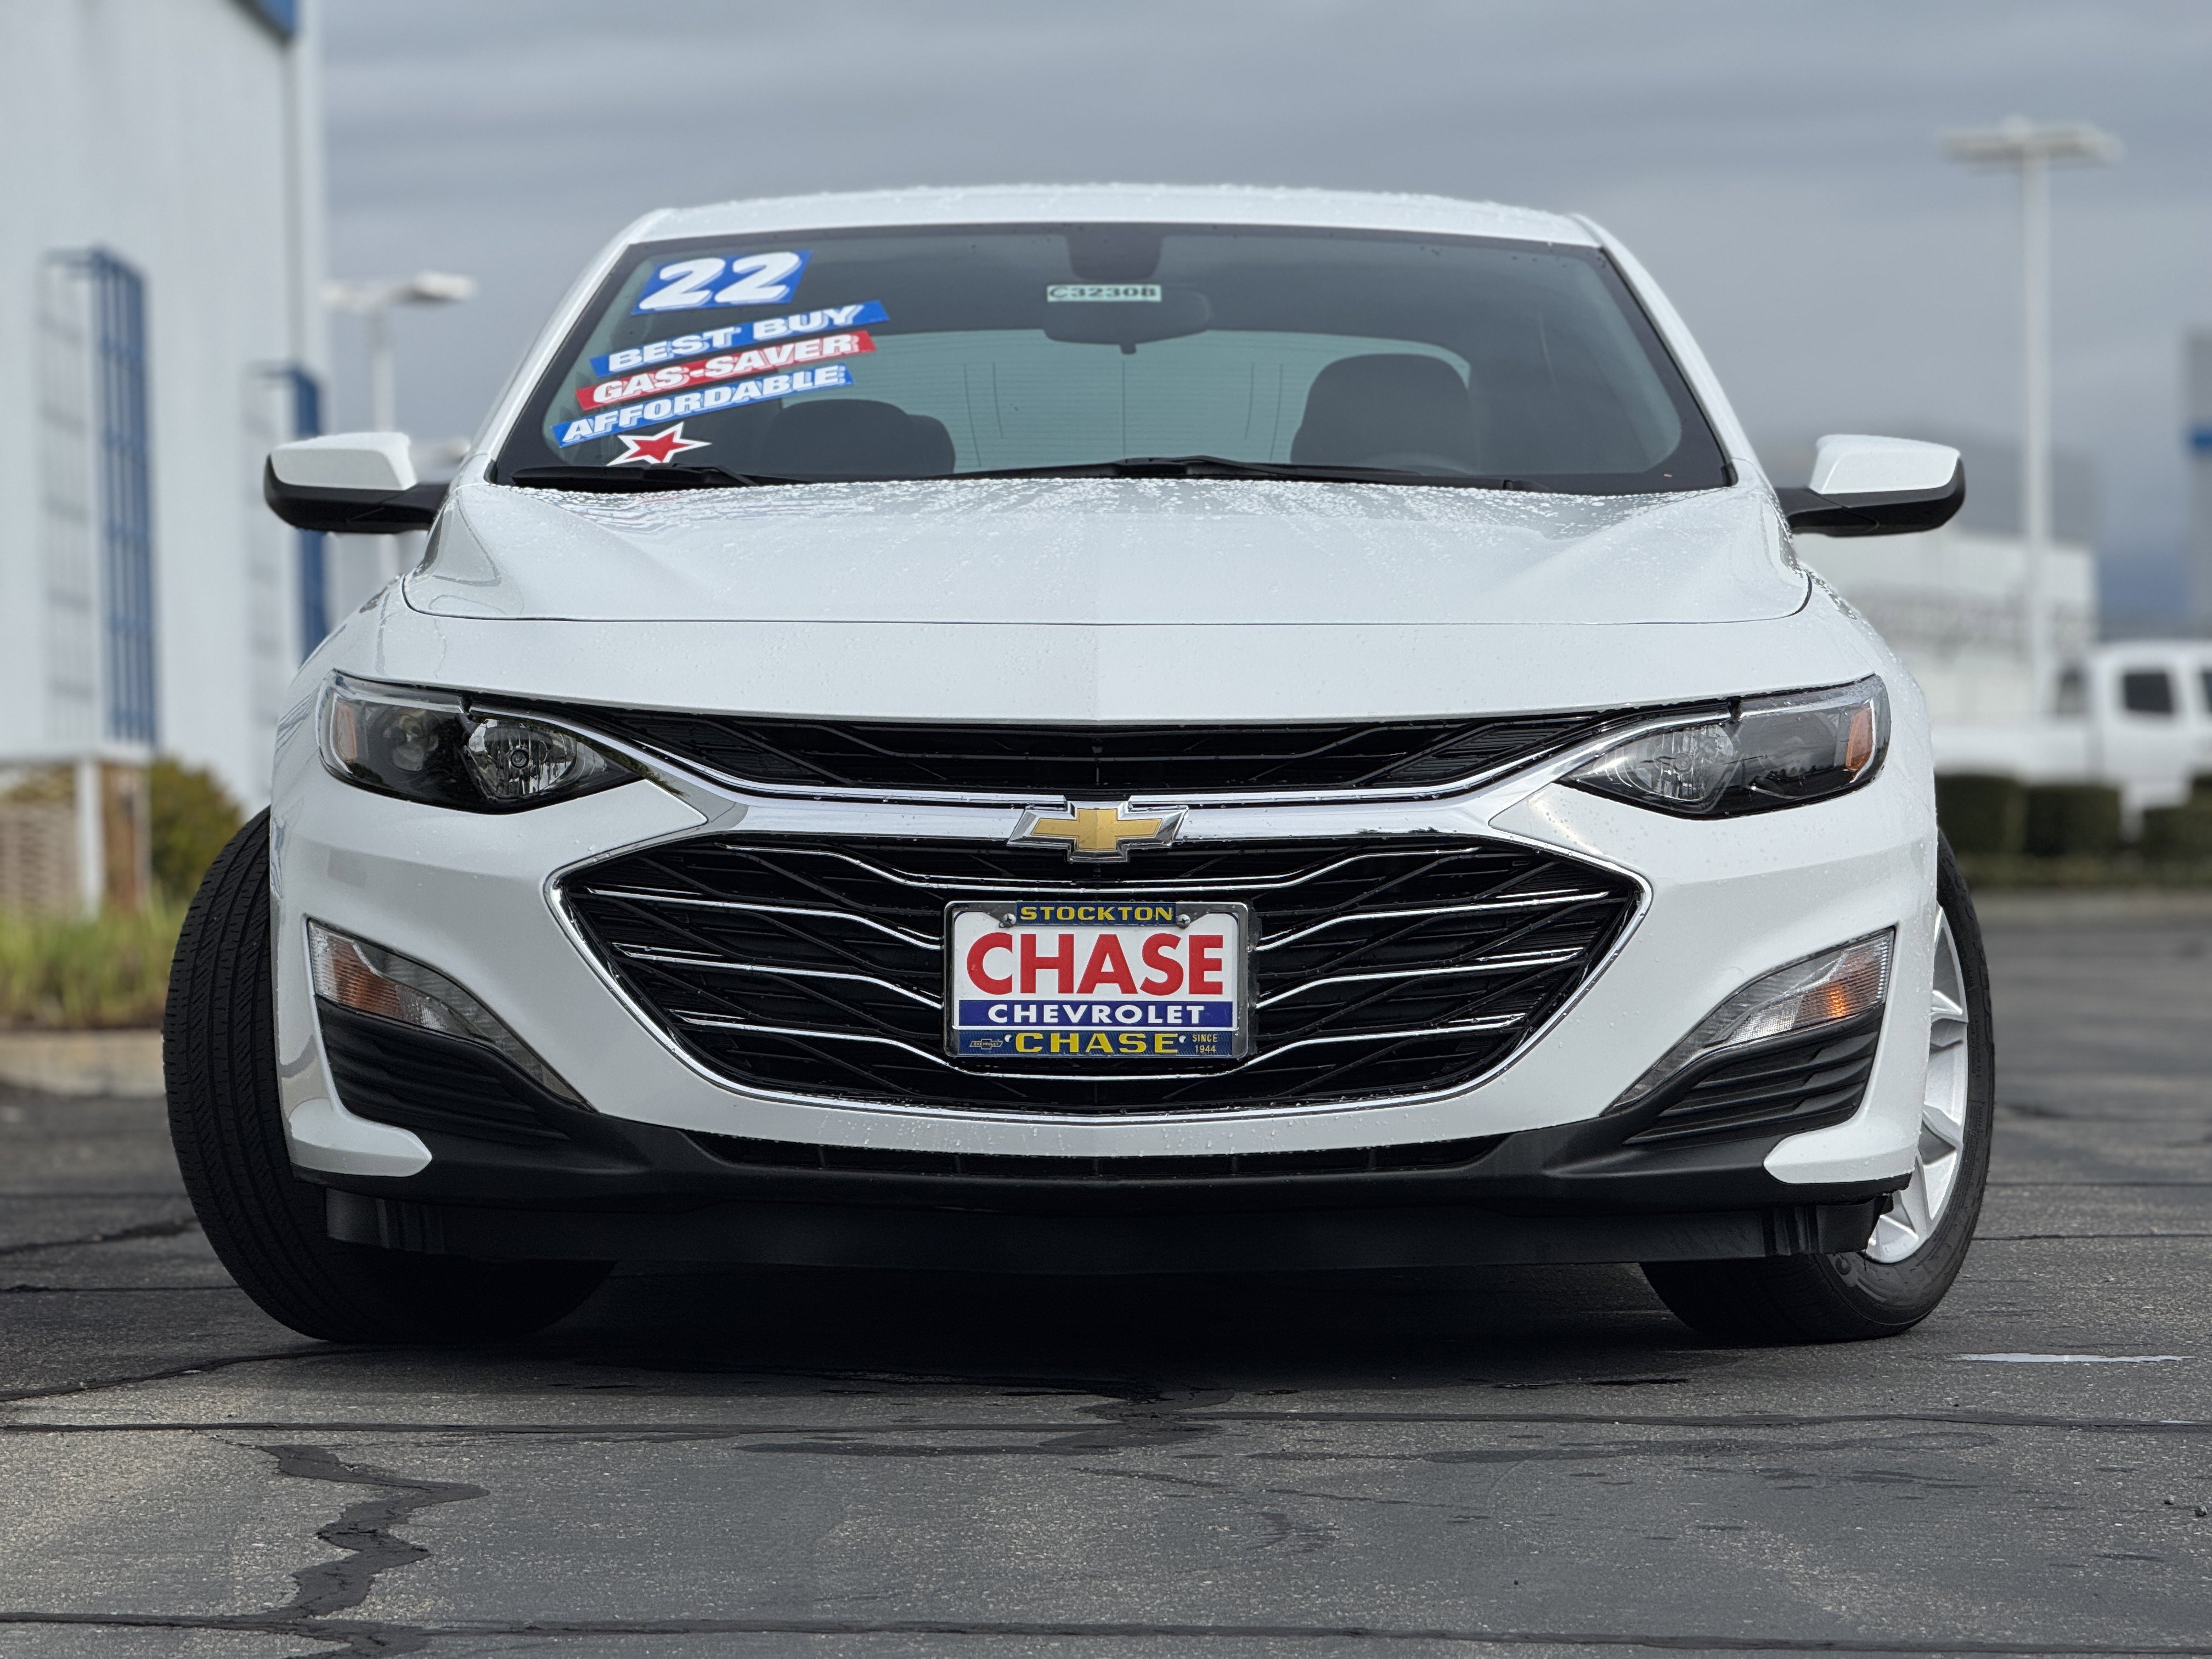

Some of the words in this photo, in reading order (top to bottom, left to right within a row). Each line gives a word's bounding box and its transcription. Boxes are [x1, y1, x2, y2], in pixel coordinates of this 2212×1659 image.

[639, 252, 801, 311] 22
[608, 326, 742, 372] BEST
[753, 305, 865, 342] BUY
[592, 333, 860, 405] GAS-SAVER
[561, 364, 845, 443] AFFORDABLE
[1020, 906, 1172, 921] STOCKTON
[967, 932, 1223, 996] CHASE
[988, 1004, 1205, 1024] CHEVROLET
[1015, 1032, 1178, 1053] CHASE
[1192, 1034, 1218, 1043] SINCE
[1195, 1045, 1216, 1053] 1944
